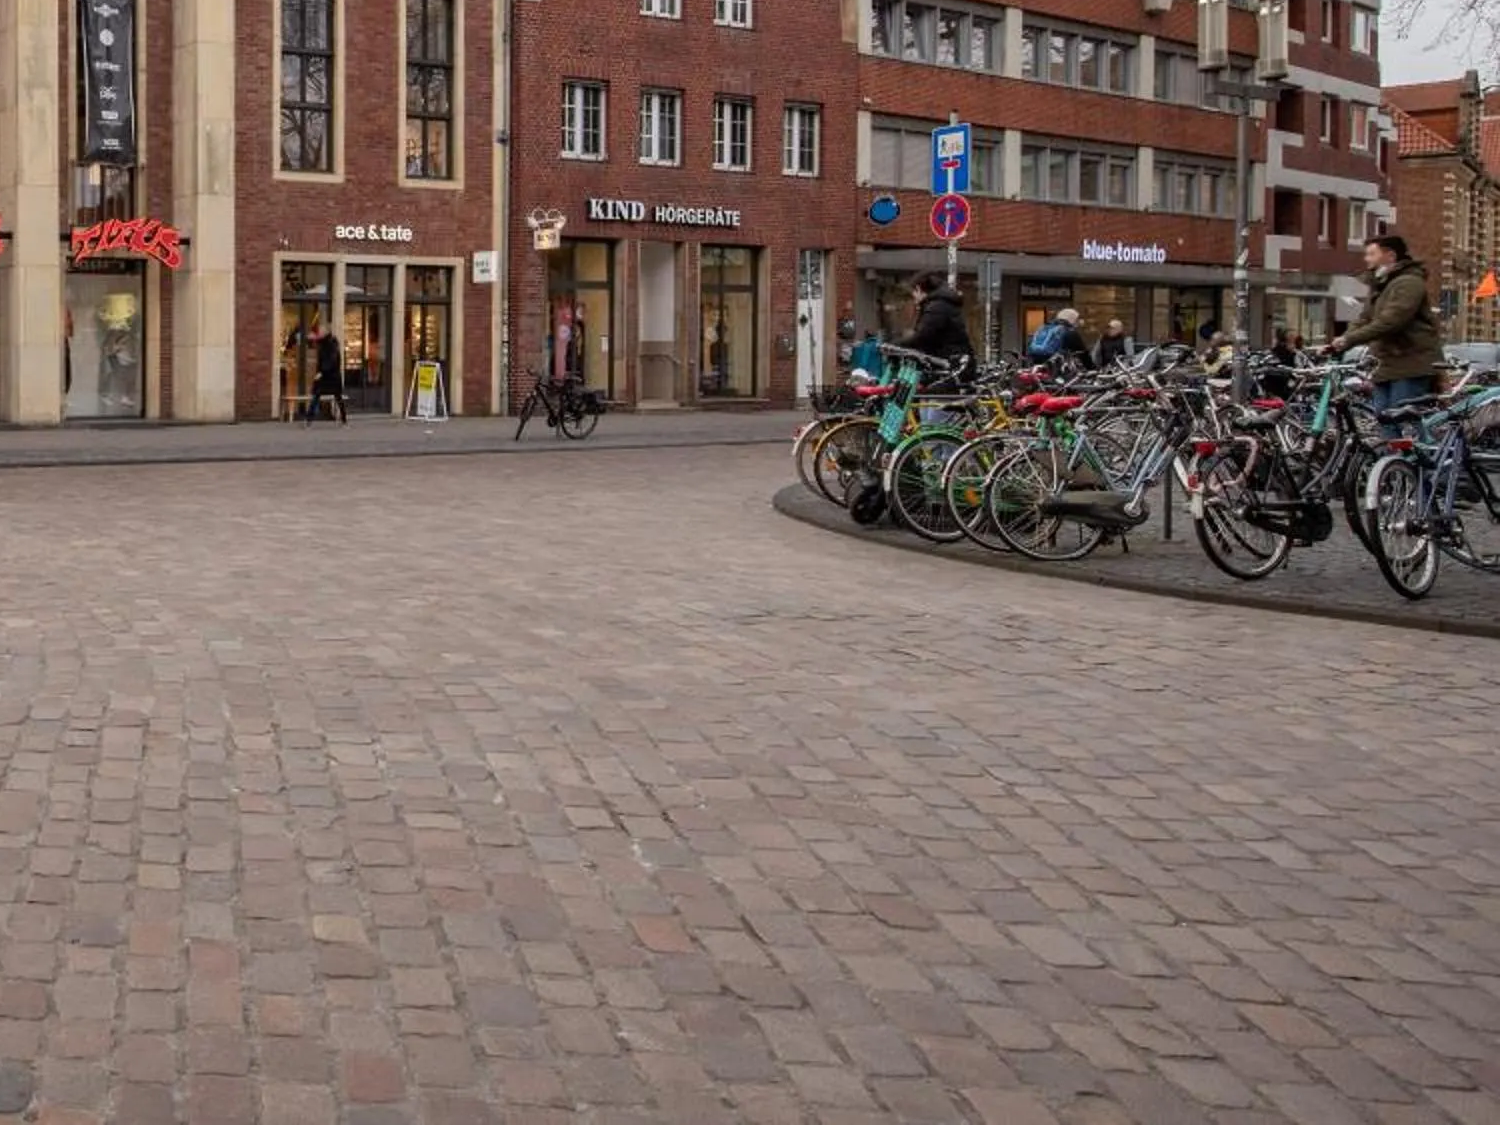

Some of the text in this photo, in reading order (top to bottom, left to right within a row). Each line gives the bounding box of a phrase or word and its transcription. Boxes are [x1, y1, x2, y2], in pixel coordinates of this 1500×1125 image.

[589, 198, 741, 226] KIND HÖRGERÄTE
[335, 225, 412, 242] ace & tate
[1082, 239, 1166, 264] blue-tomato
